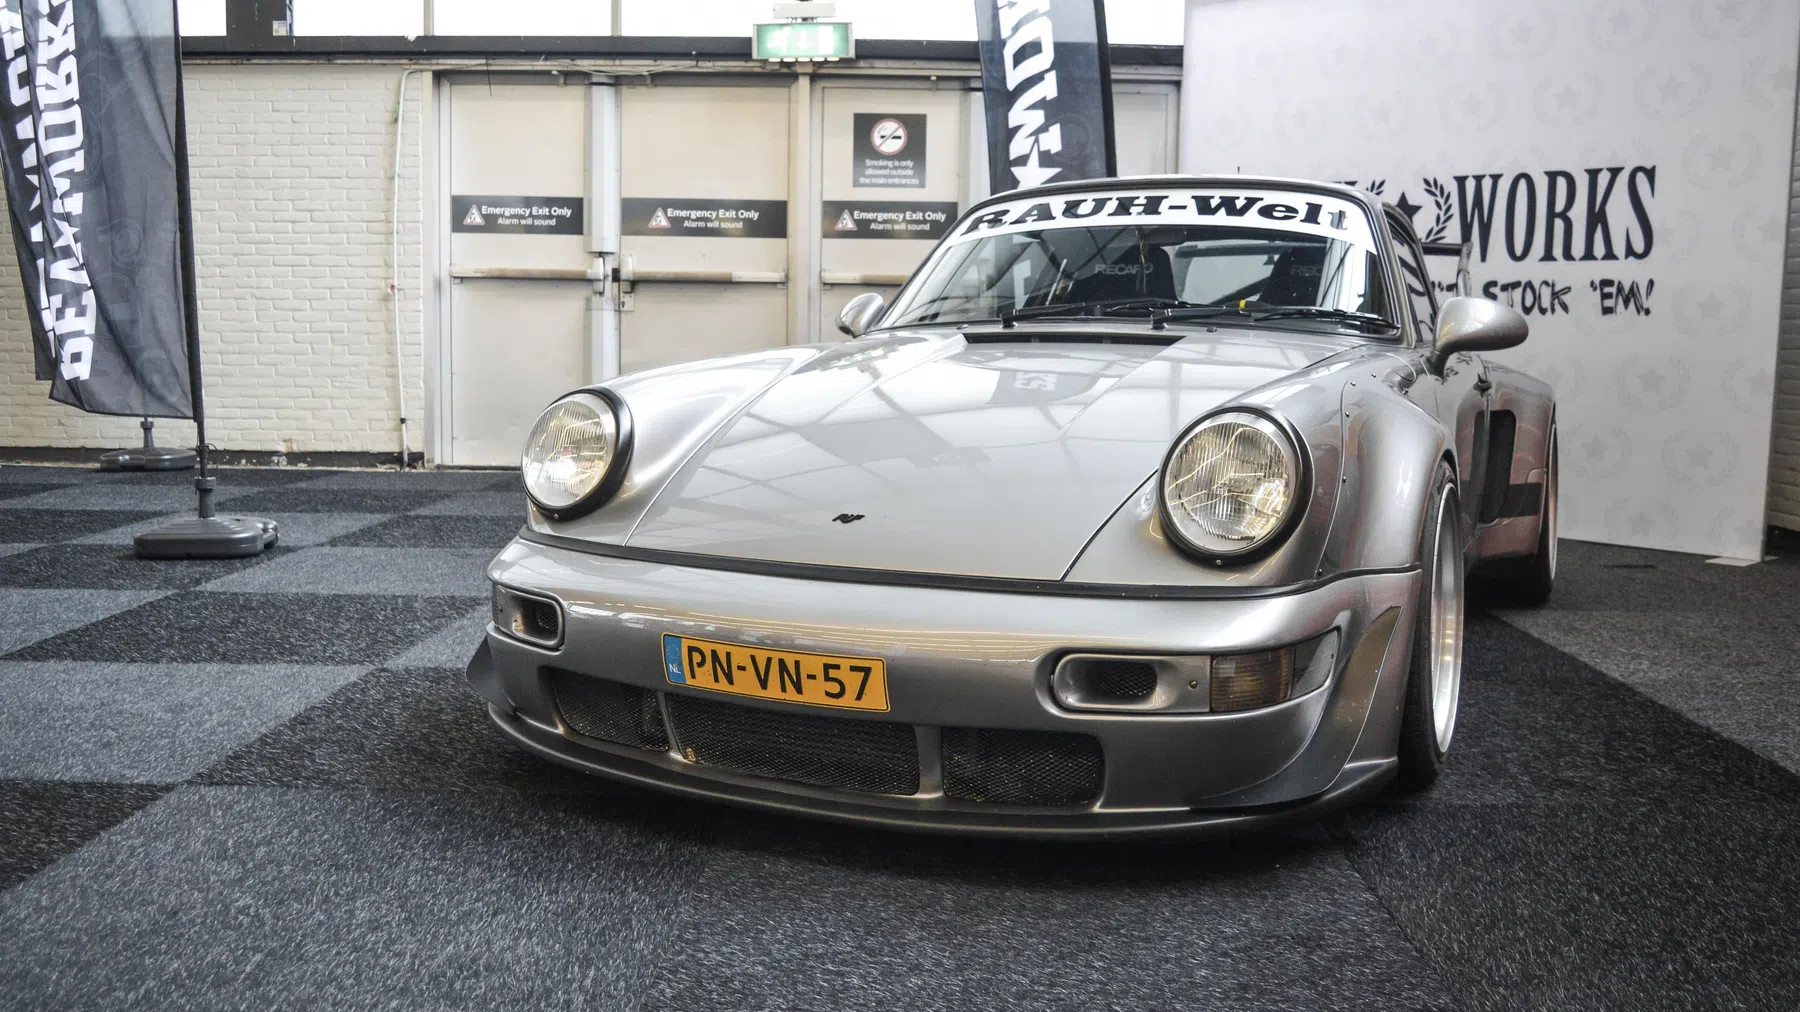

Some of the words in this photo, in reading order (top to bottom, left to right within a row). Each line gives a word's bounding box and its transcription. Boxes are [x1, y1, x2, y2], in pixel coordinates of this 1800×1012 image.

[865, 159, 894, 168] Smoking
[900, 160, 914, 168] only
[865, 168, 890, 176] allowed
[481, 205, 530, 217] Emergency
[532, 206, 549, 216] Exit
[551, 207, 572, 218] Only
[667, 208, 717, 219] Emergency
[719, 209, 736, 218] Exit
[738, 210, 760, 220] Only
[853, 211, 904, 222] Emergency
[905, 211, 924, 220] Exit
[925, 212, 946, 222] Only
[960, 195, 1348, 237] RAUH-Welt
[1453, 165, 1656, 263] WORKS
[497, 217, 519, 225] Alarm
[534, 218, 556, 226] sound
[683, 220, 705, 228] Alarm
[720, 221, 743, 229] sound
[870, 222, 892, 230] Alarm
[893, 222, 906, 230] will
[907, 223, 930, 231] sound
[1483, 279, 1571, 316] STOCK
[669, 663, 681, 675] NL
[687, 645, 873, 701] PN-VN-57
